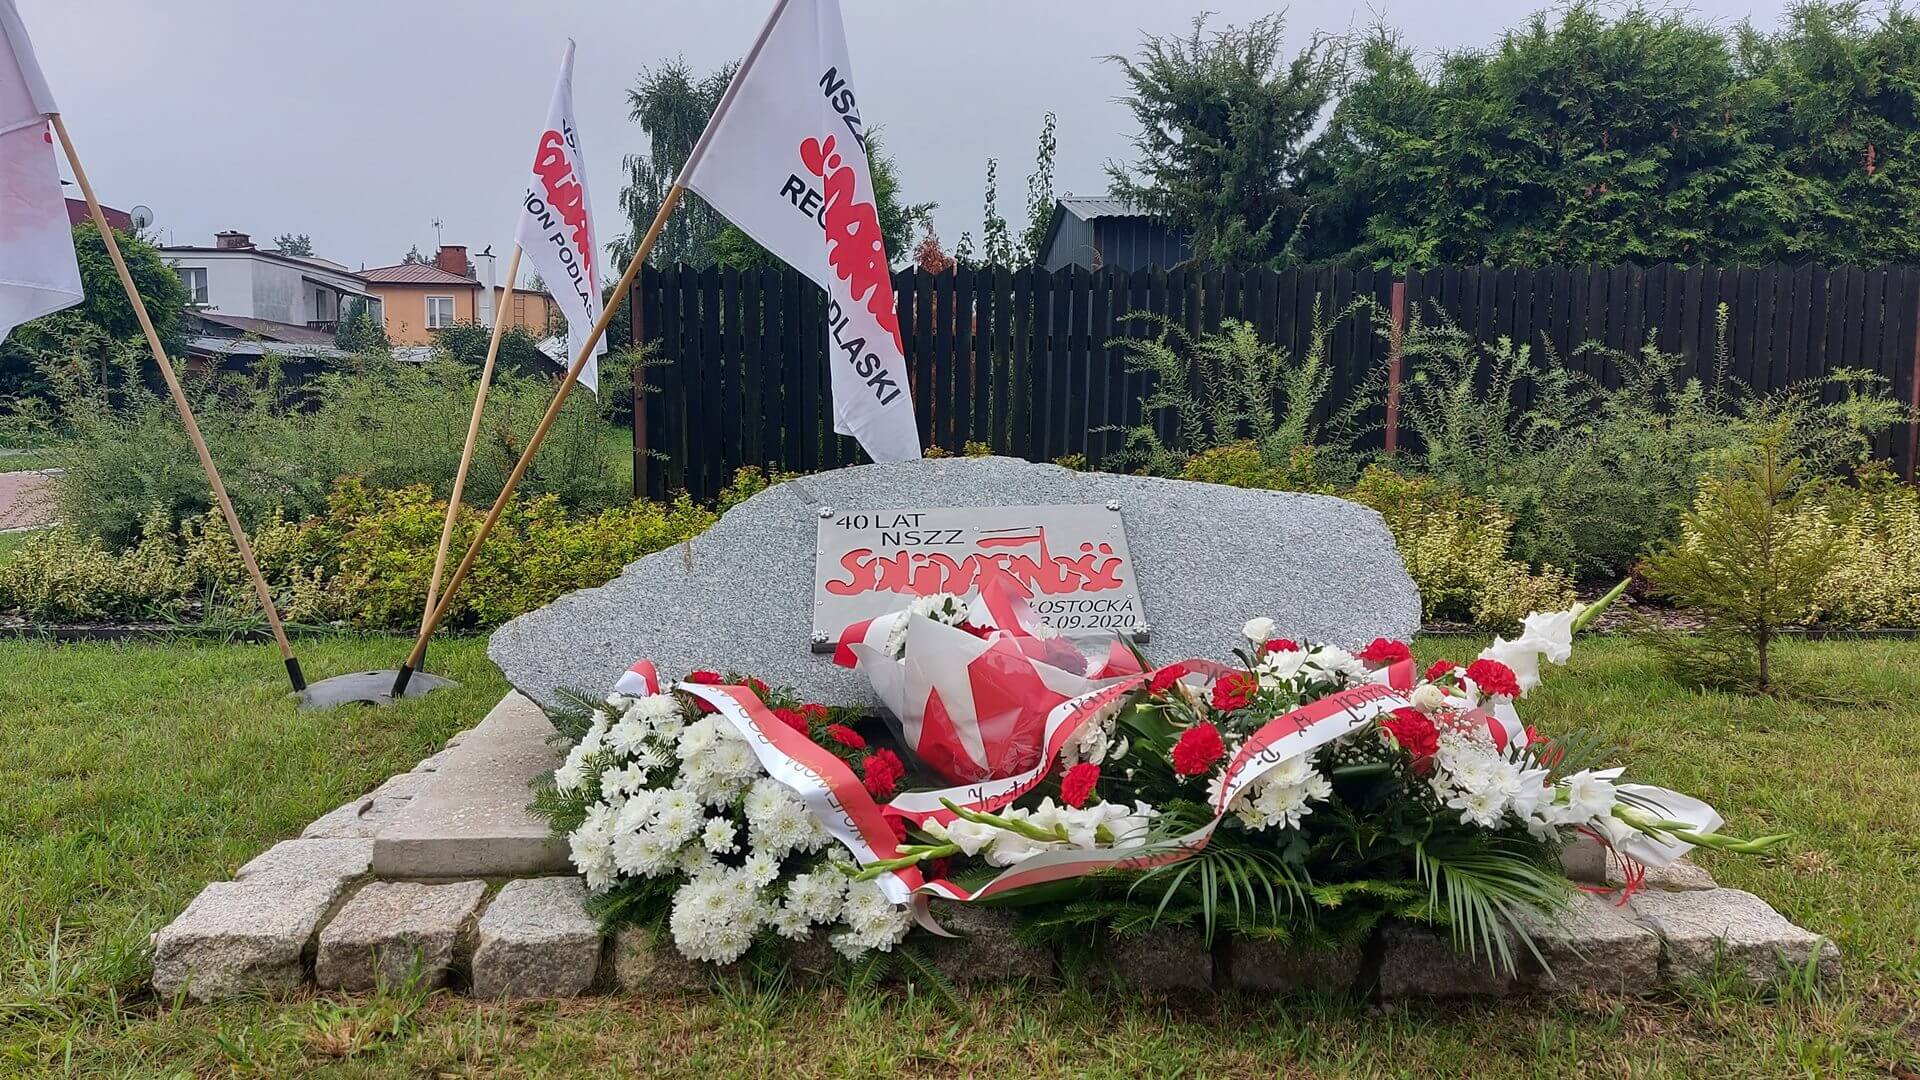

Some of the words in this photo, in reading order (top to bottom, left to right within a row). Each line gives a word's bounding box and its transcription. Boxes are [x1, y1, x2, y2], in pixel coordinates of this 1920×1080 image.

[523, 189, 555, 231] ION
[828, 288, 901, 407] DLASKI
[835, 514, 868, 530] 40
[874, 513, 926, 529] LAT
[881, 530, 965, 546] NSZZ
